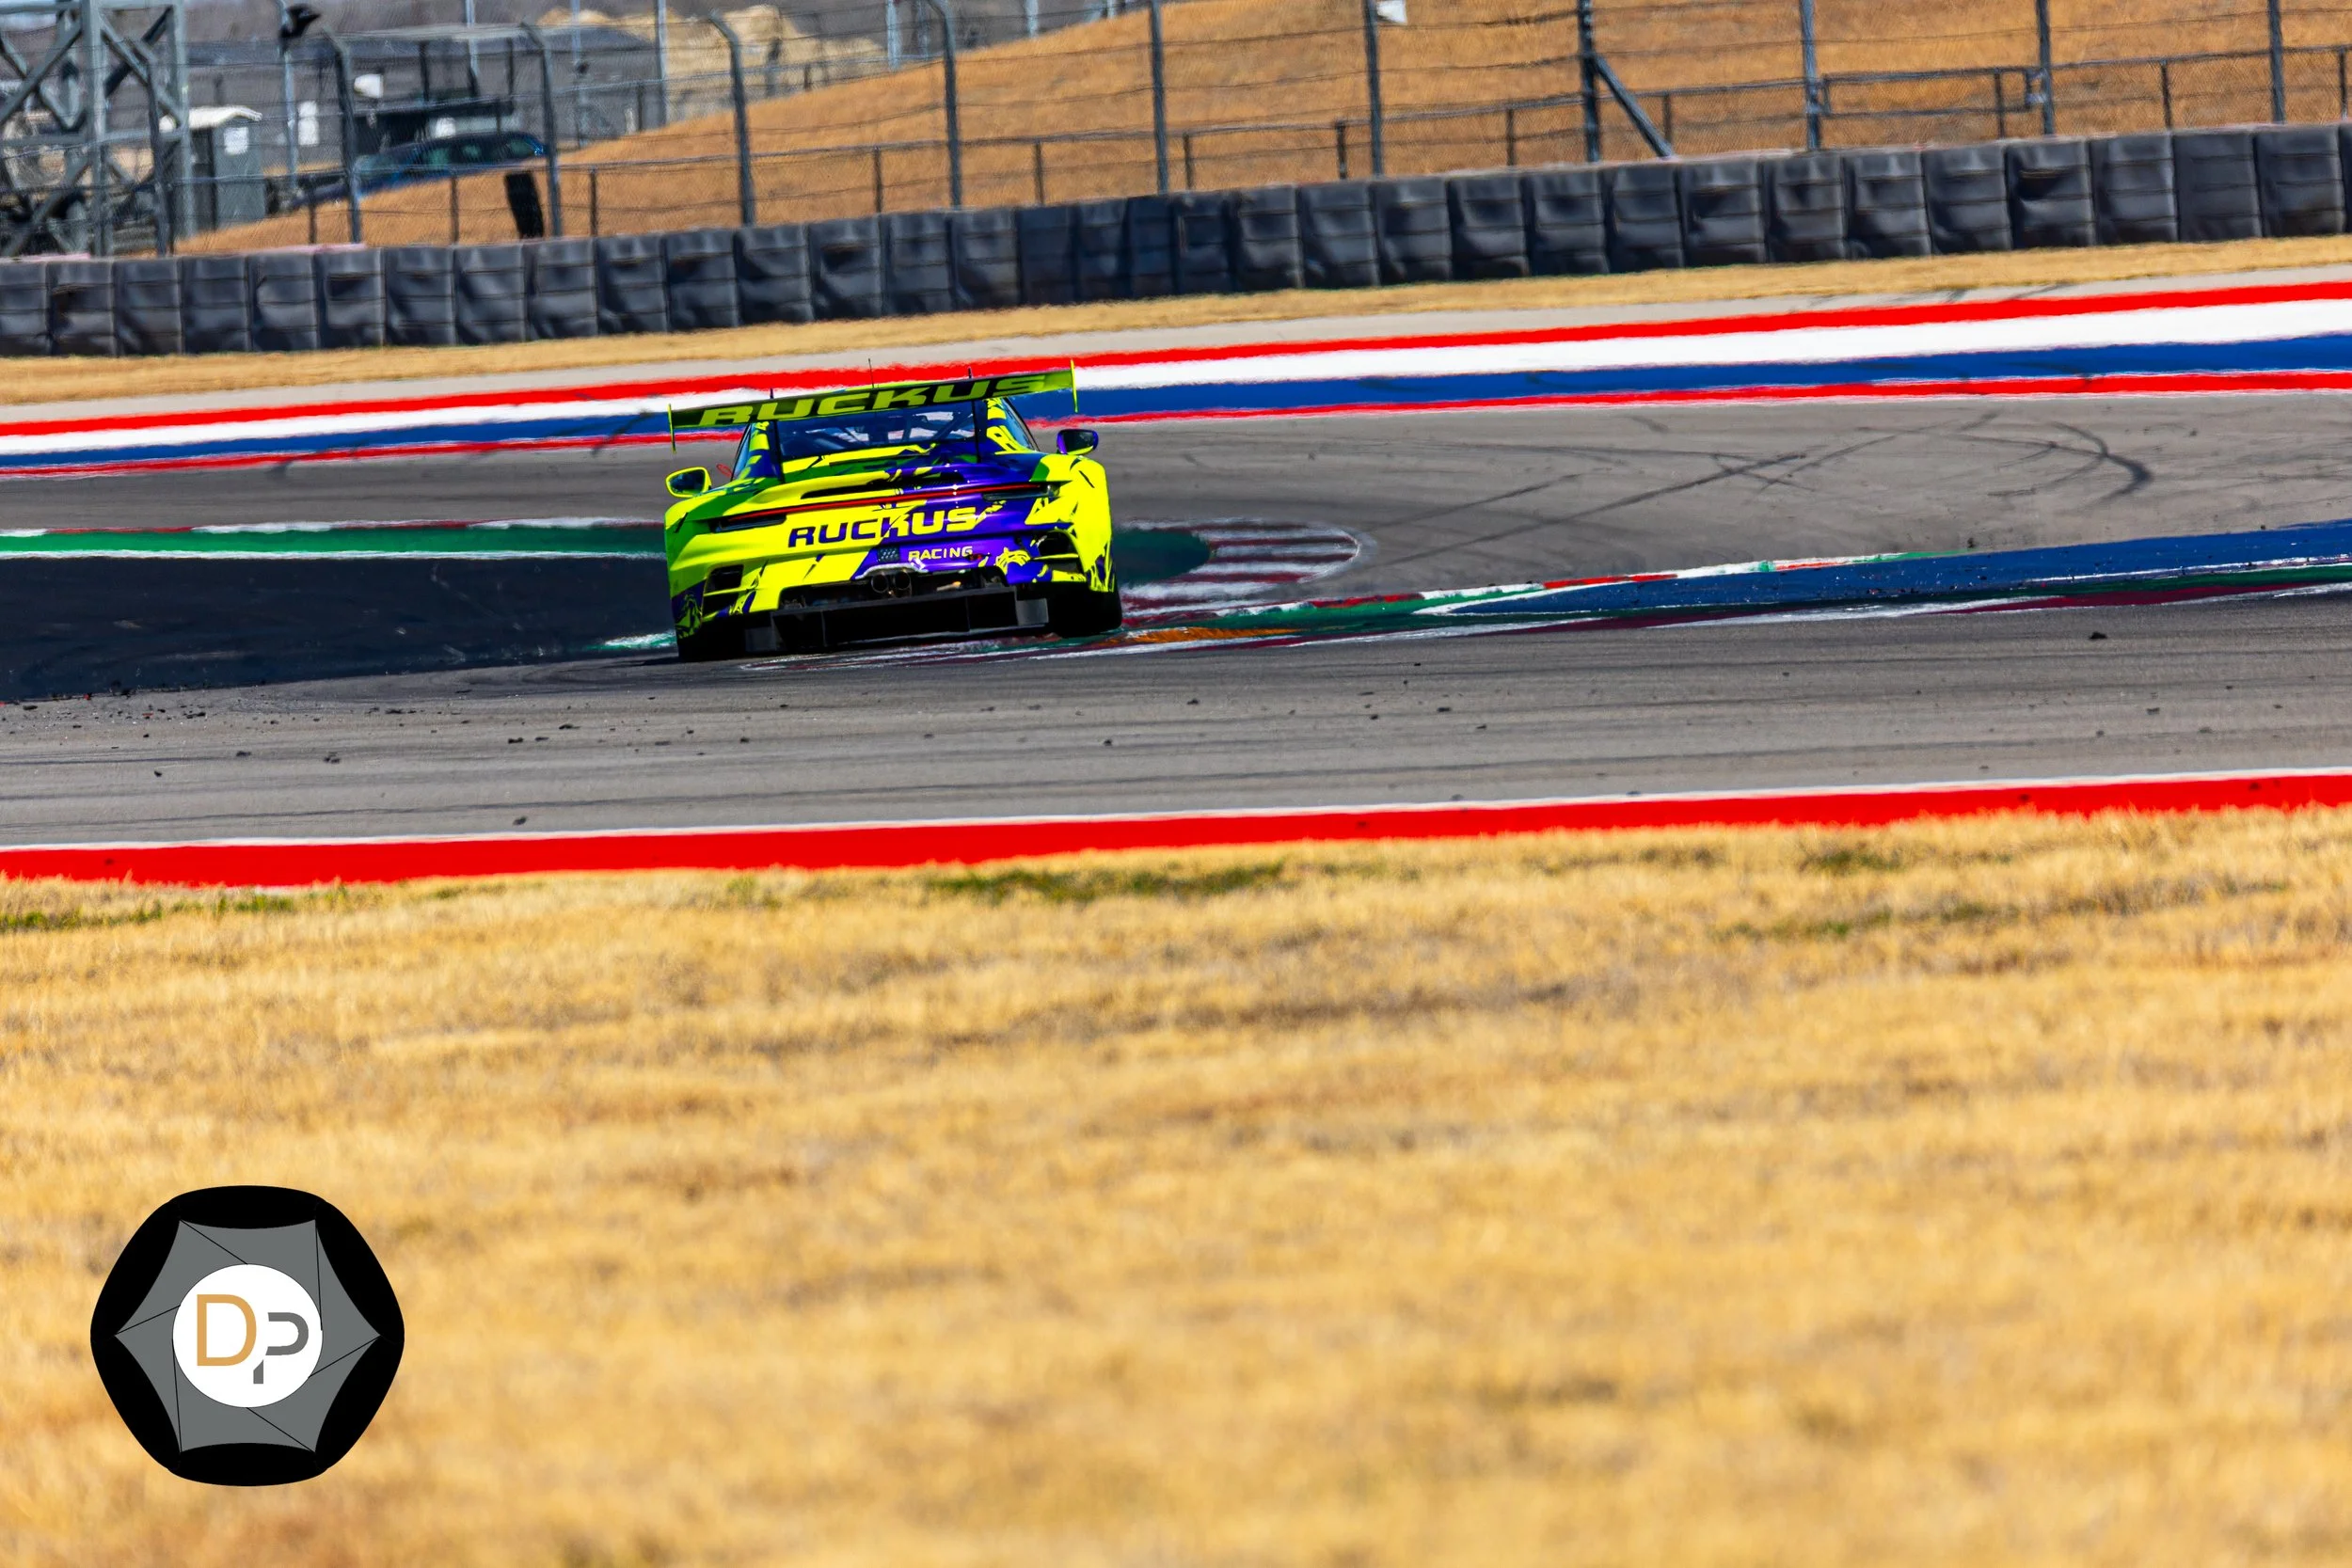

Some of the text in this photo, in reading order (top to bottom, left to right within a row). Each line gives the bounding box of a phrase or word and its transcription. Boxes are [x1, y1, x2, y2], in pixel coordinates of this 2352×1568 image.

[699, 374, 1046, 427] RUCKUS
[787, 506, 977, 548] RUCKUS
[908, 546, 973, 562] RACING
